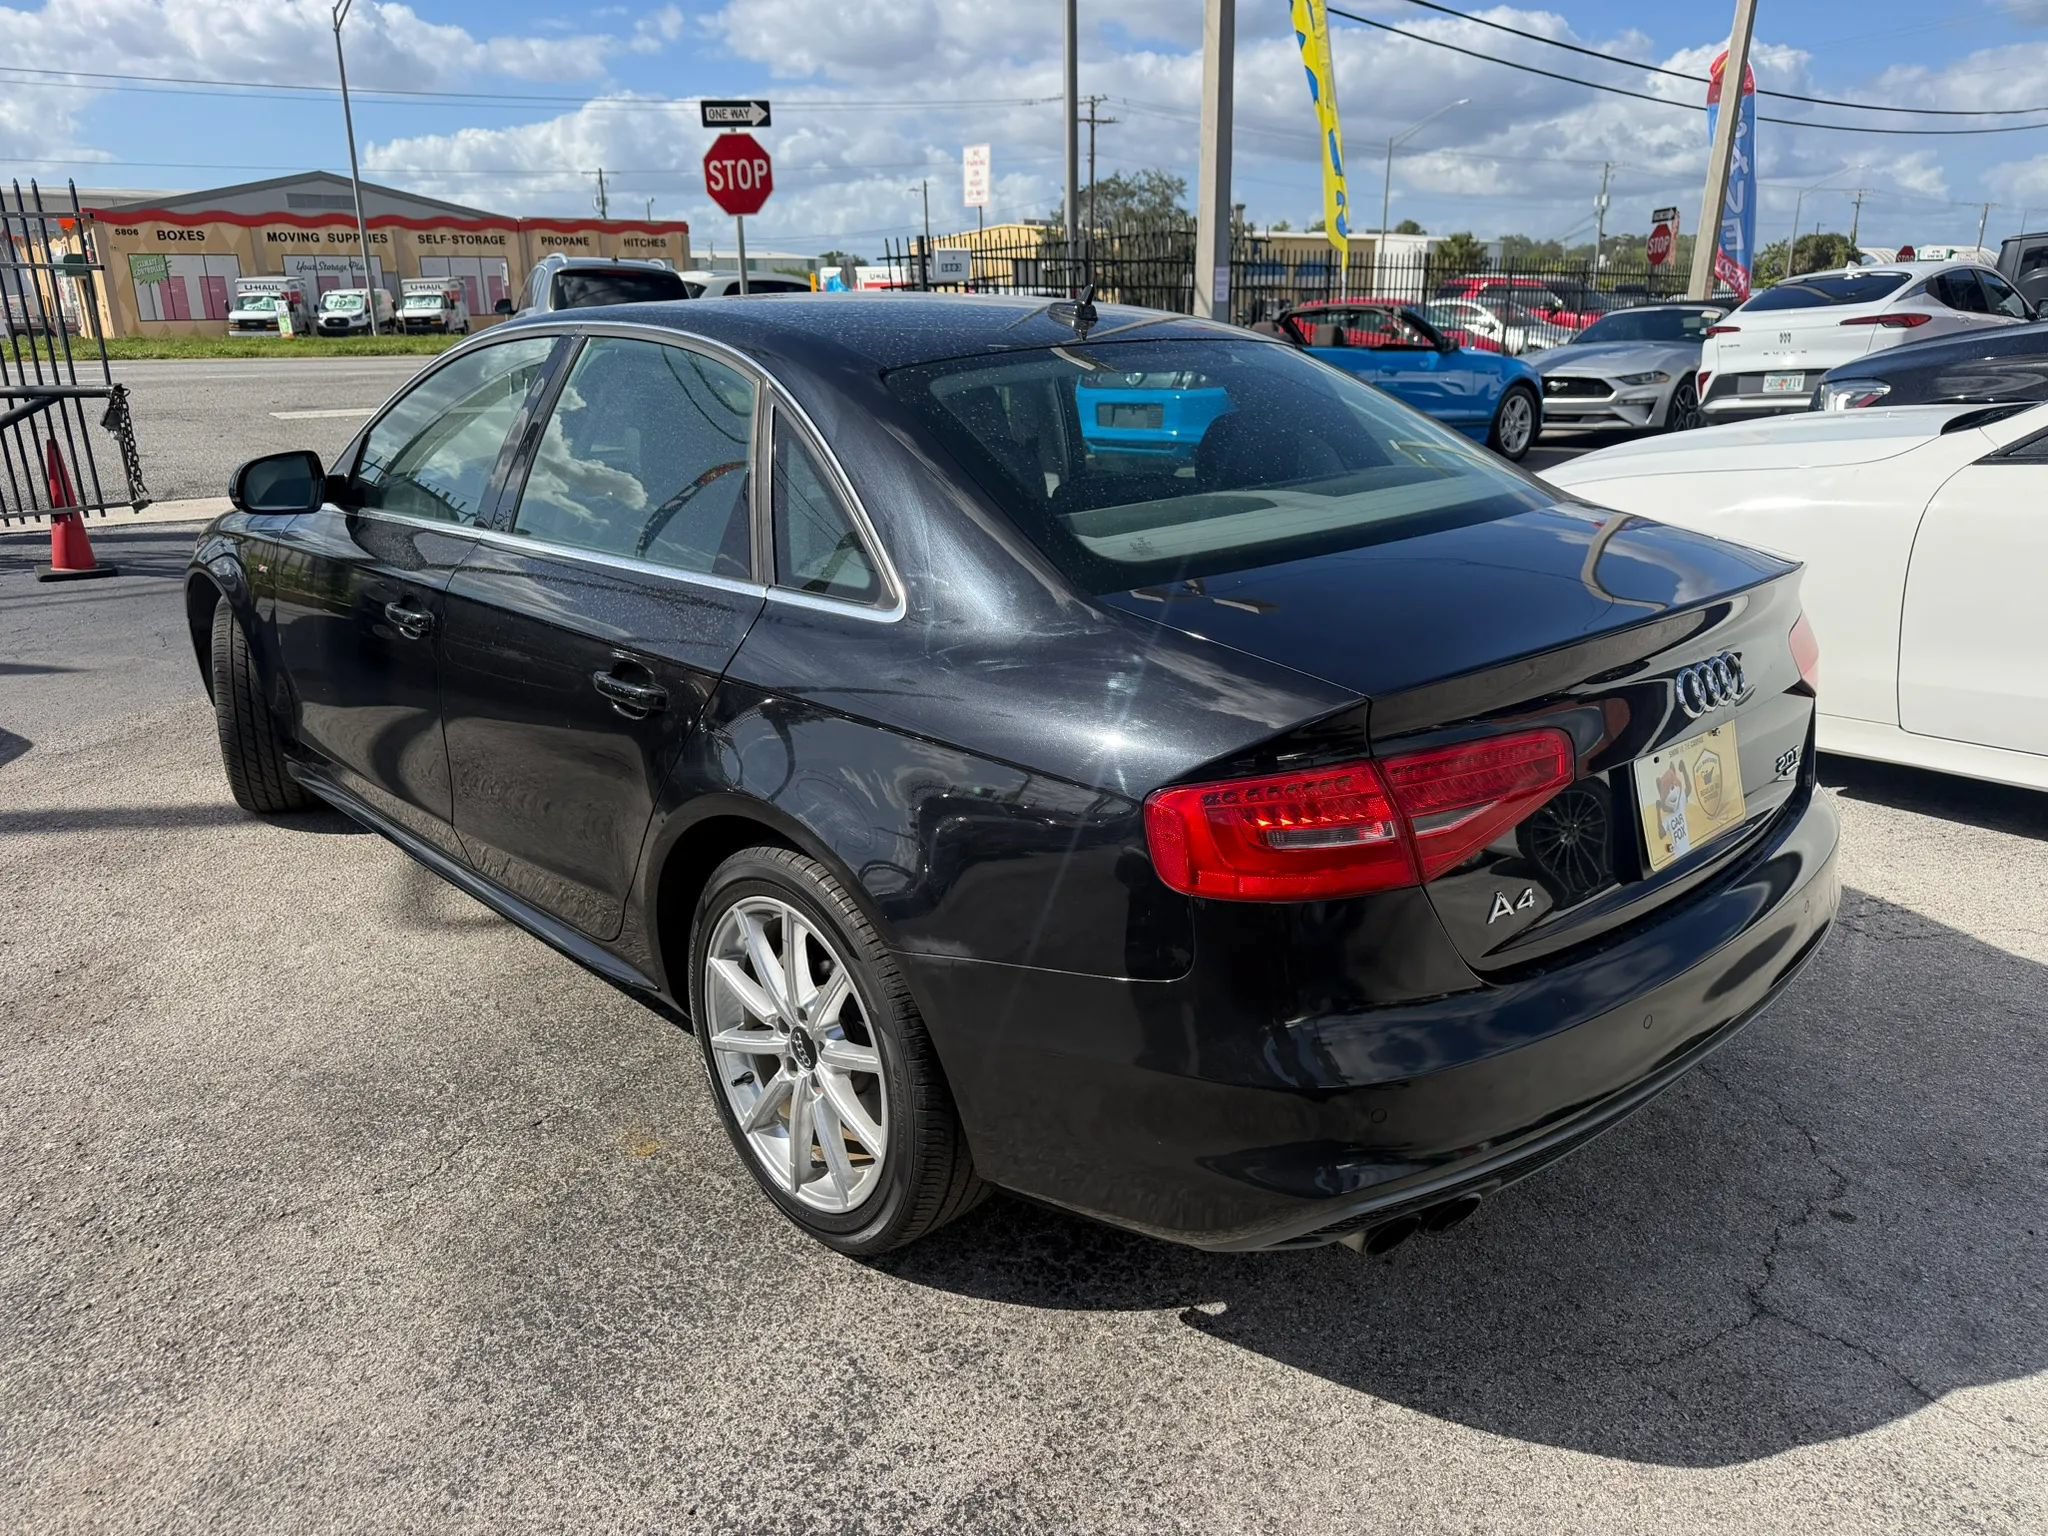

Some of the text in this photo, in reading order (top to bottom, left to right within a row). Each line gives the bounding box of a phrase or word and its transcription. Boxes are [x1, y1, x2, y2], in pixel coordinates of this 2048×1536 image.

[708, 108, 750, 119] ONE WAY
[708, 158, 768, 191] STOP
[115, 228, 139, 236] 5806
[156, 230, 205, 241] BOXES
[267, 232, 388, 243] MOVING SUPPIES
[418, 235, 506, 245] SELF-STORAGE
[541, 237, 590, 247] PROPANE
[624, 238, 667, 248] HITCHES
[1649, 236, 1670, 254] STOP
[296, 261, 315, 272] Your
[1671, 813, 1684, 830] CAR
[1673, 827, 1686, 843] FOX
[1487, 888, 1535, 924] A4
